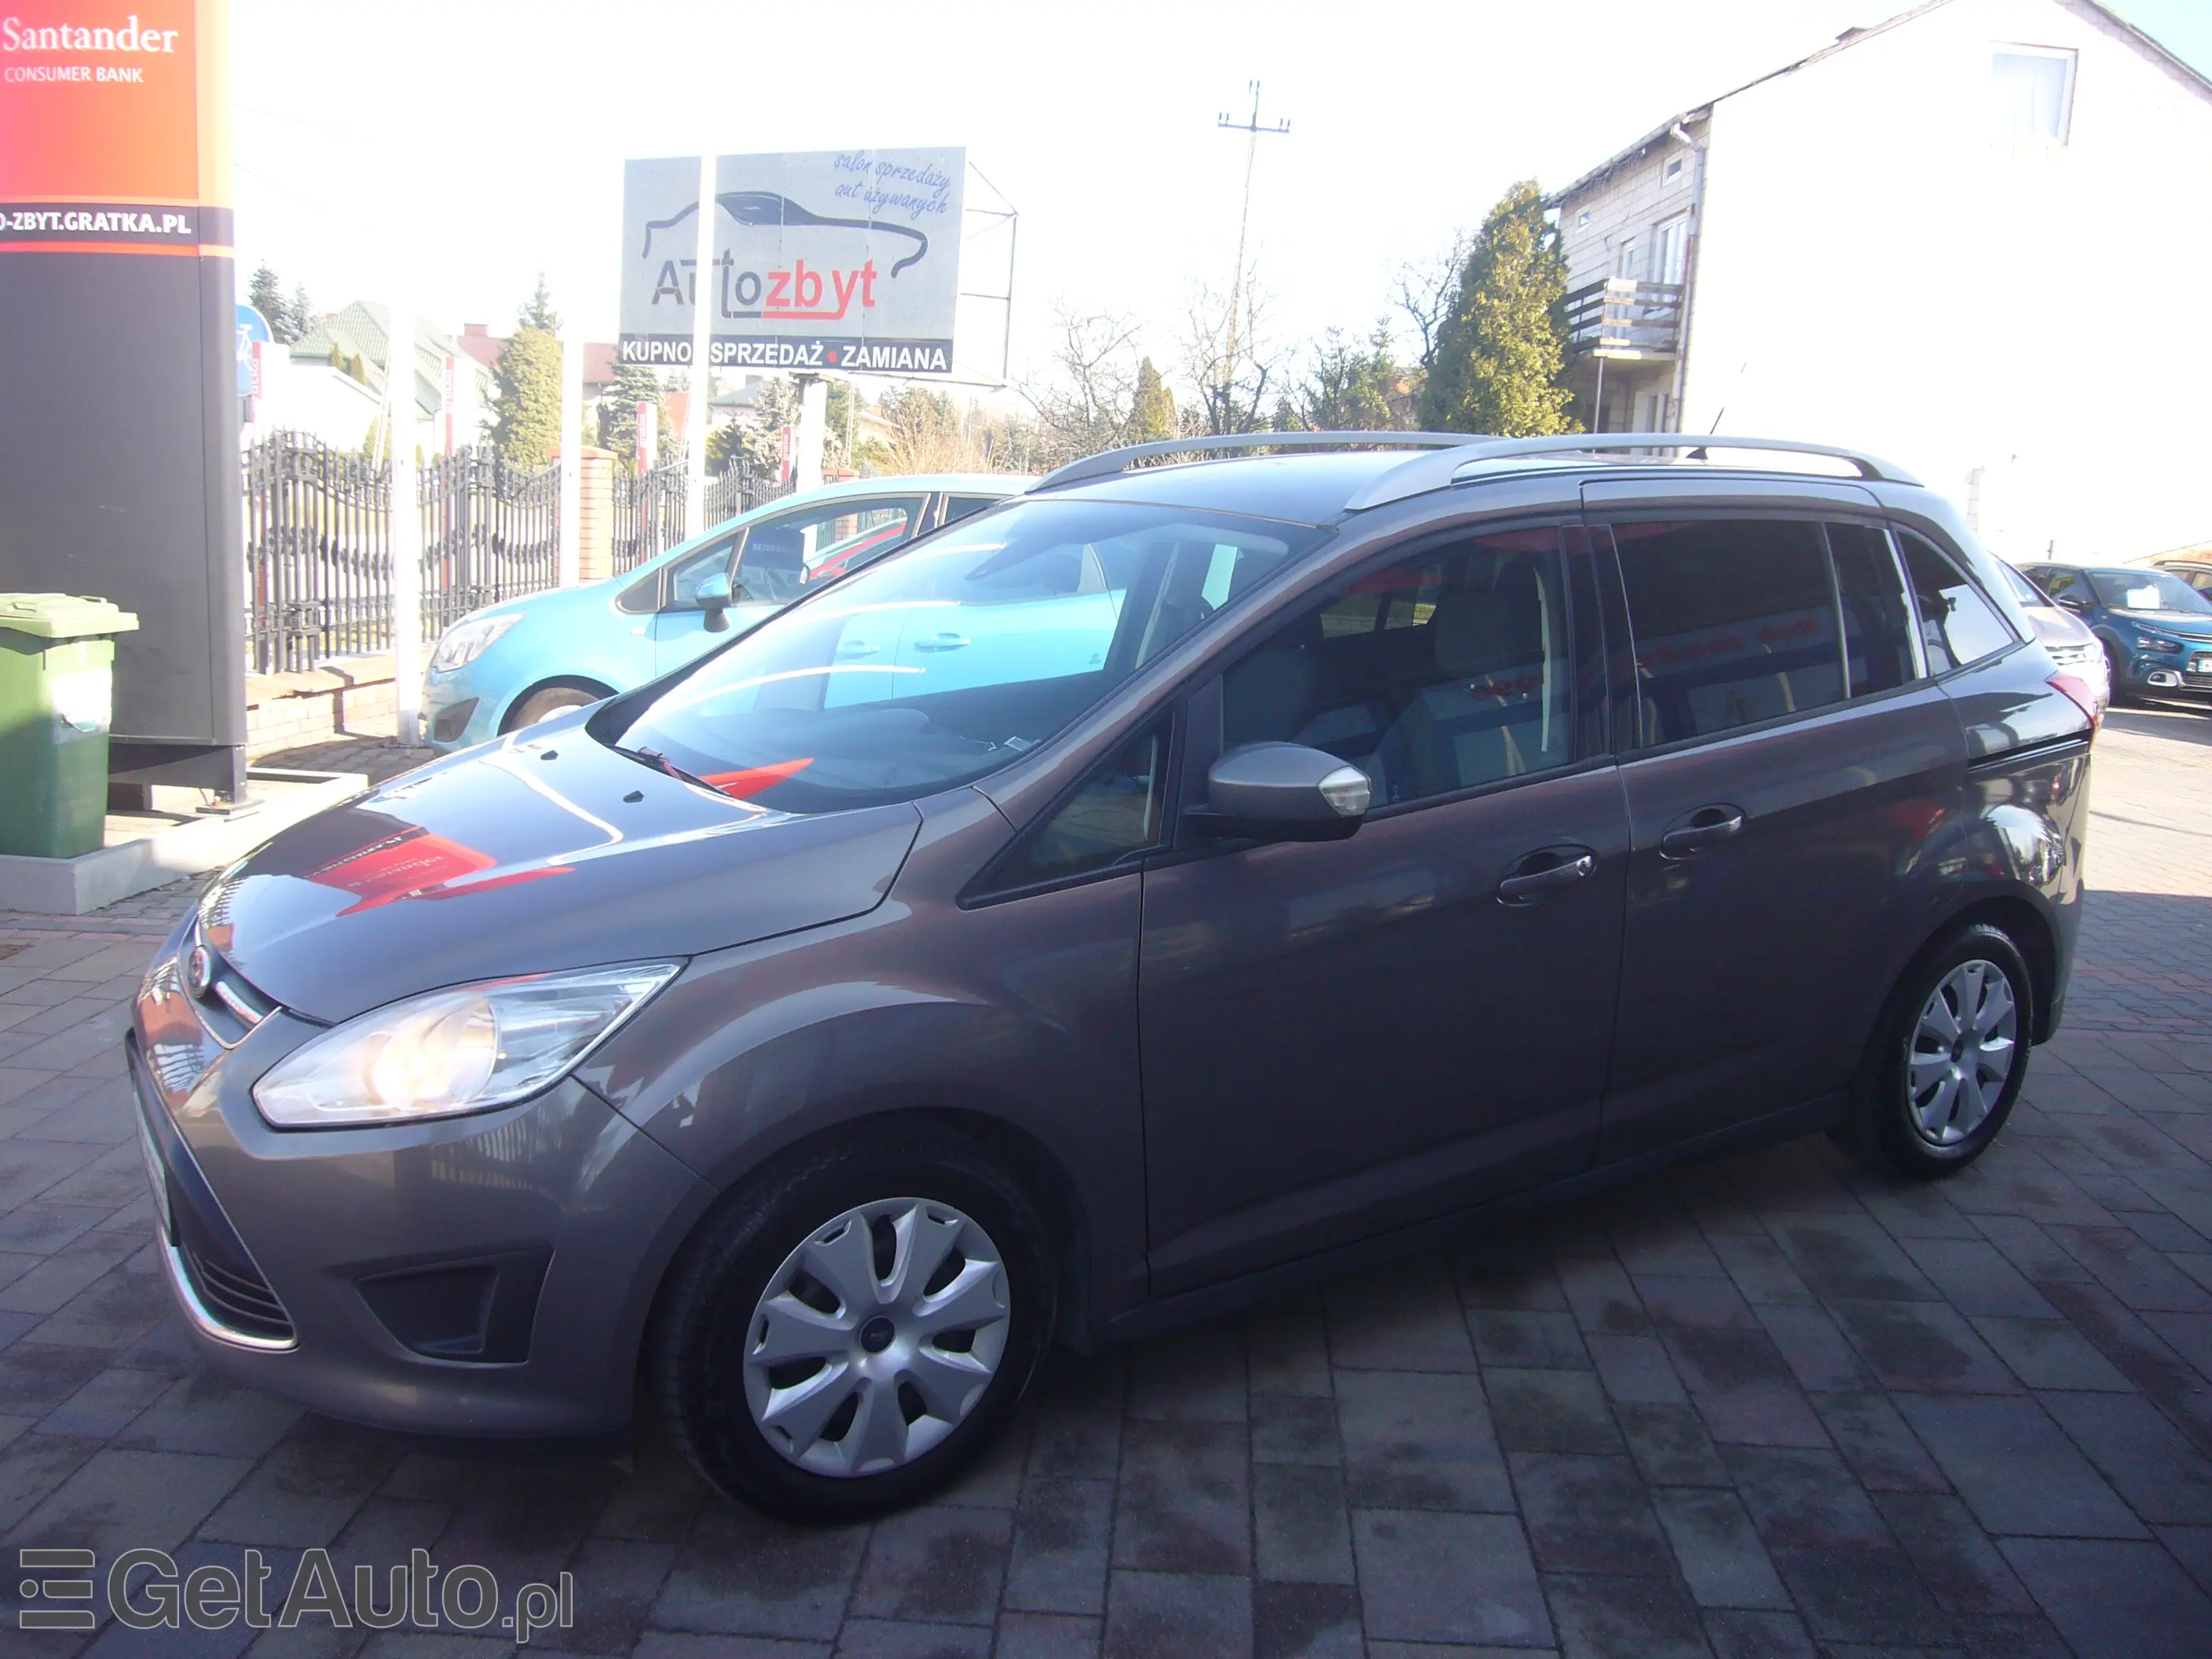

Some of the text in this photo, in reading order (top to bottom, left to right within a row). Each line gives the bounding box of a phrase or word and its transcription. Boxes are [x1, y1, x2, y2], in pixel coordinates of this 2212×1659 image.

[2, 14, 179, 53] Santander
[5, 66, 145, 83] CONSUMER BANK
[834, 149, 951, 199] salon sprzedaży
[835, 181, 950, 220] aut używanych
[622, 339, 947, 371] KUPNO SPRZEDAŻ ZAMIANA
